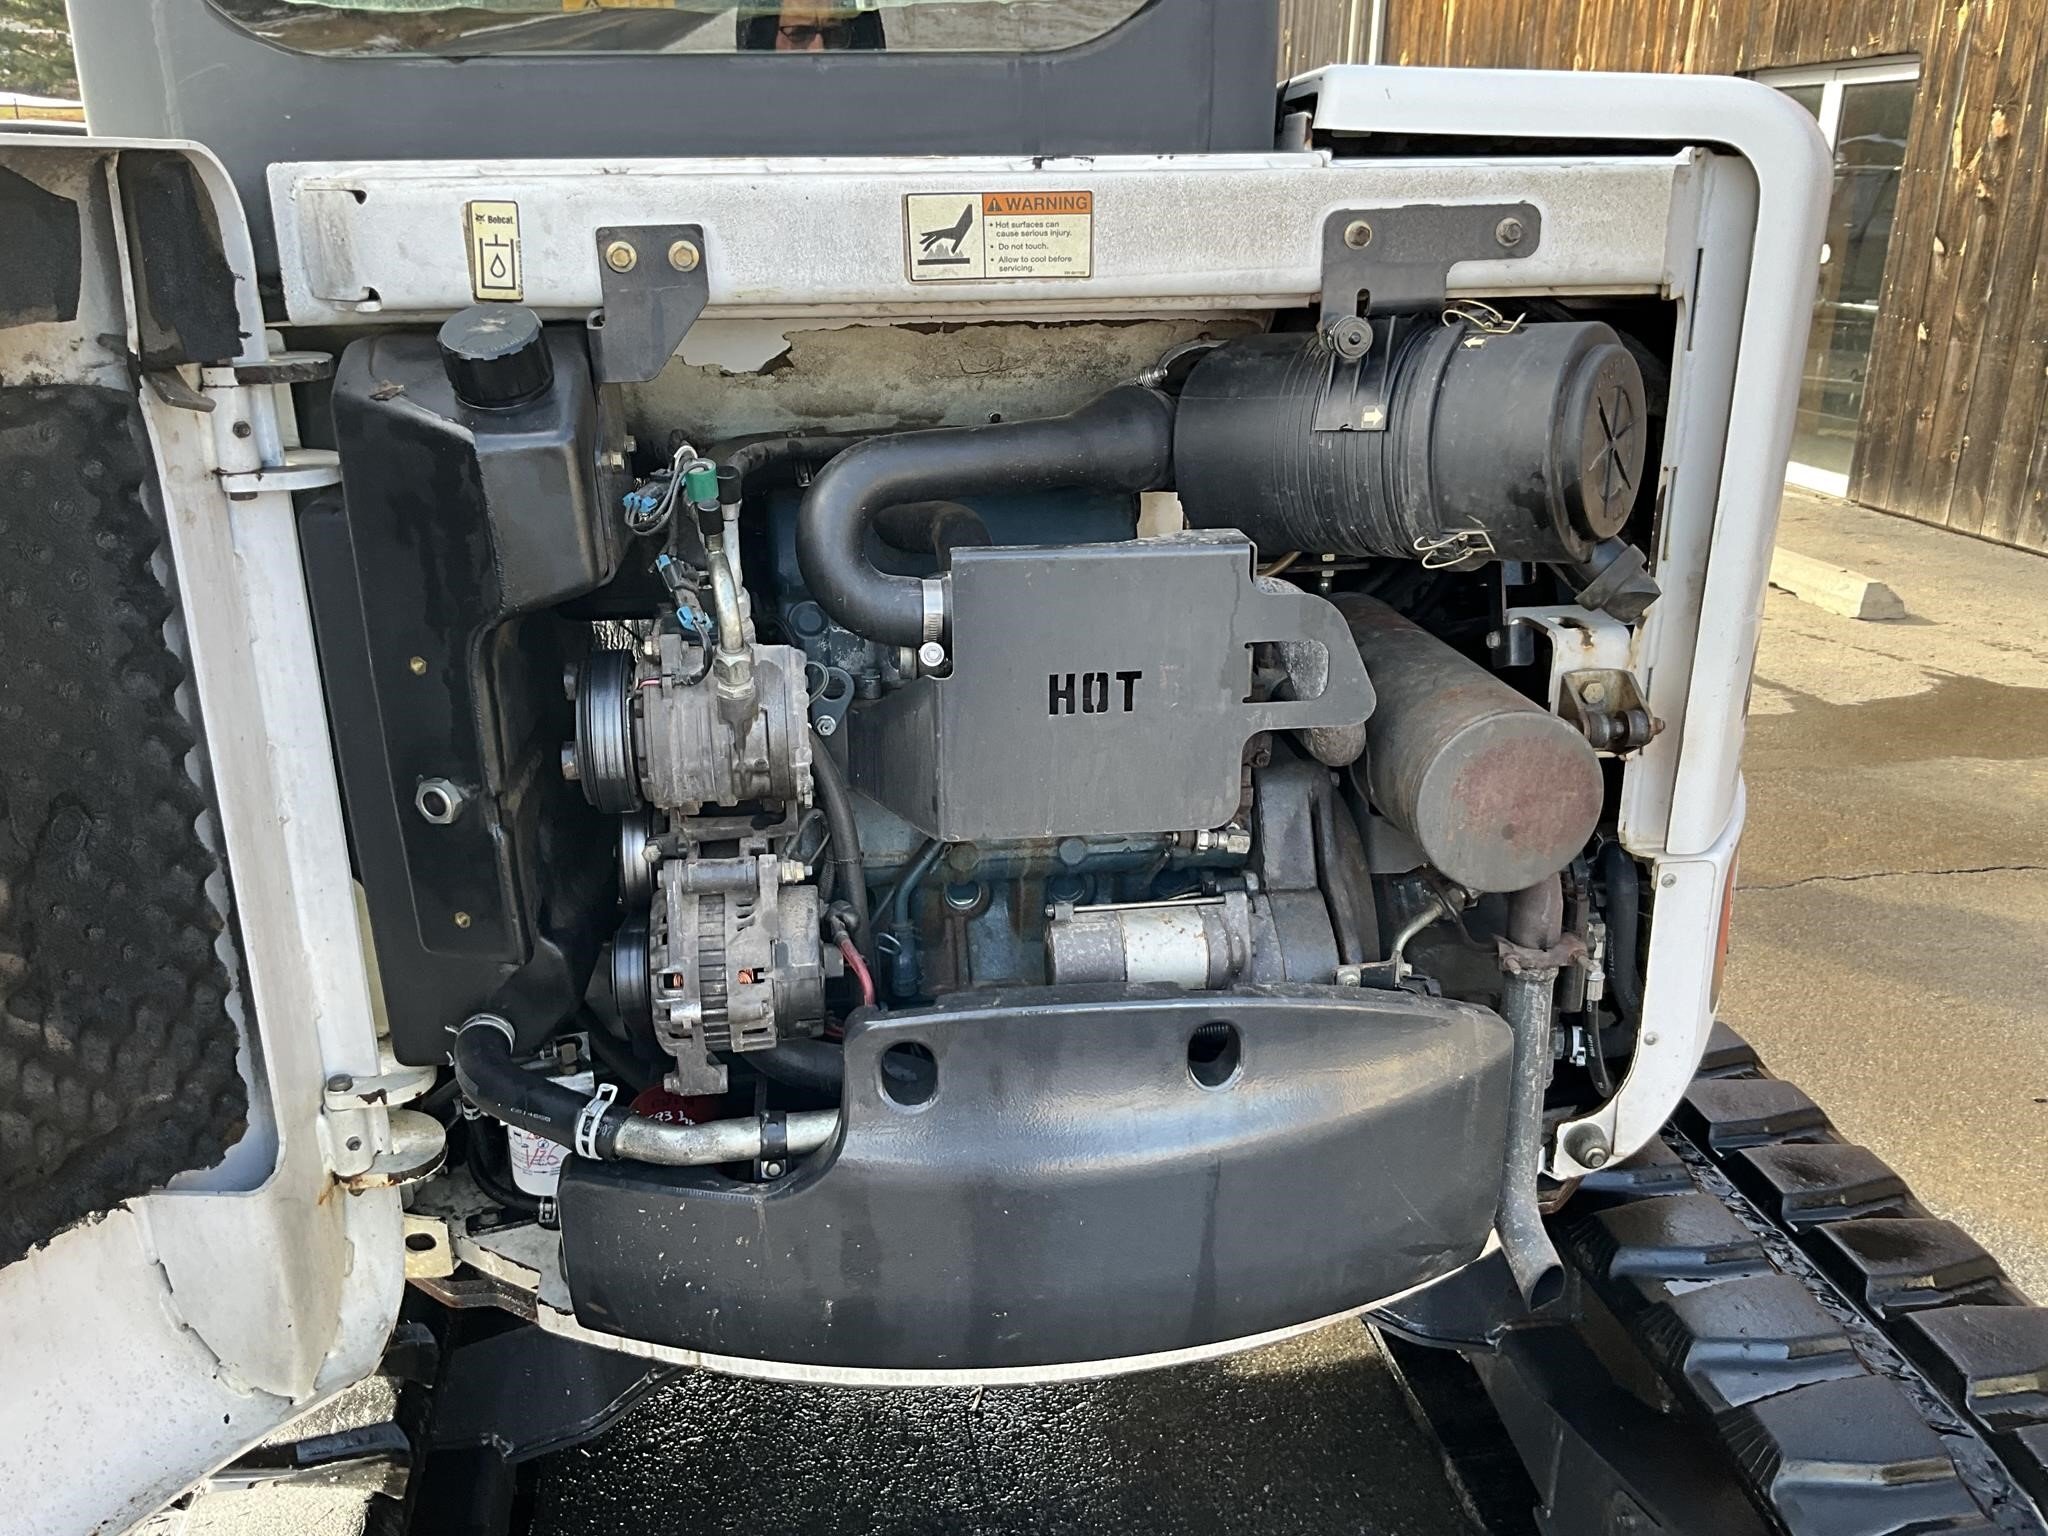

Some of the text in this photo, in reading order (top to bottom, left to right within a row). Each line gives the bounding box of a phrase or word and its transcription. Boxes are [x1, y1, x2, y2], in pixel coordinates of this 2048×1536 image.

[1005, 196, 1088, 211] WARNING
[487, 215, 514, 225] Bobcat
[1011, 221, 1044, 229] surfaces
[1050, 229, 1073, 238] injury.
[998, 243, 1010, 251] Do
[1025, 242, 1049, 250] touch.
[998, 256, 1020, 264] Allow
[1048, 255, 1073, 263] before
[999, 264, 1035, 273] servicing.
[1049, 670, 1142, 715] HOT
